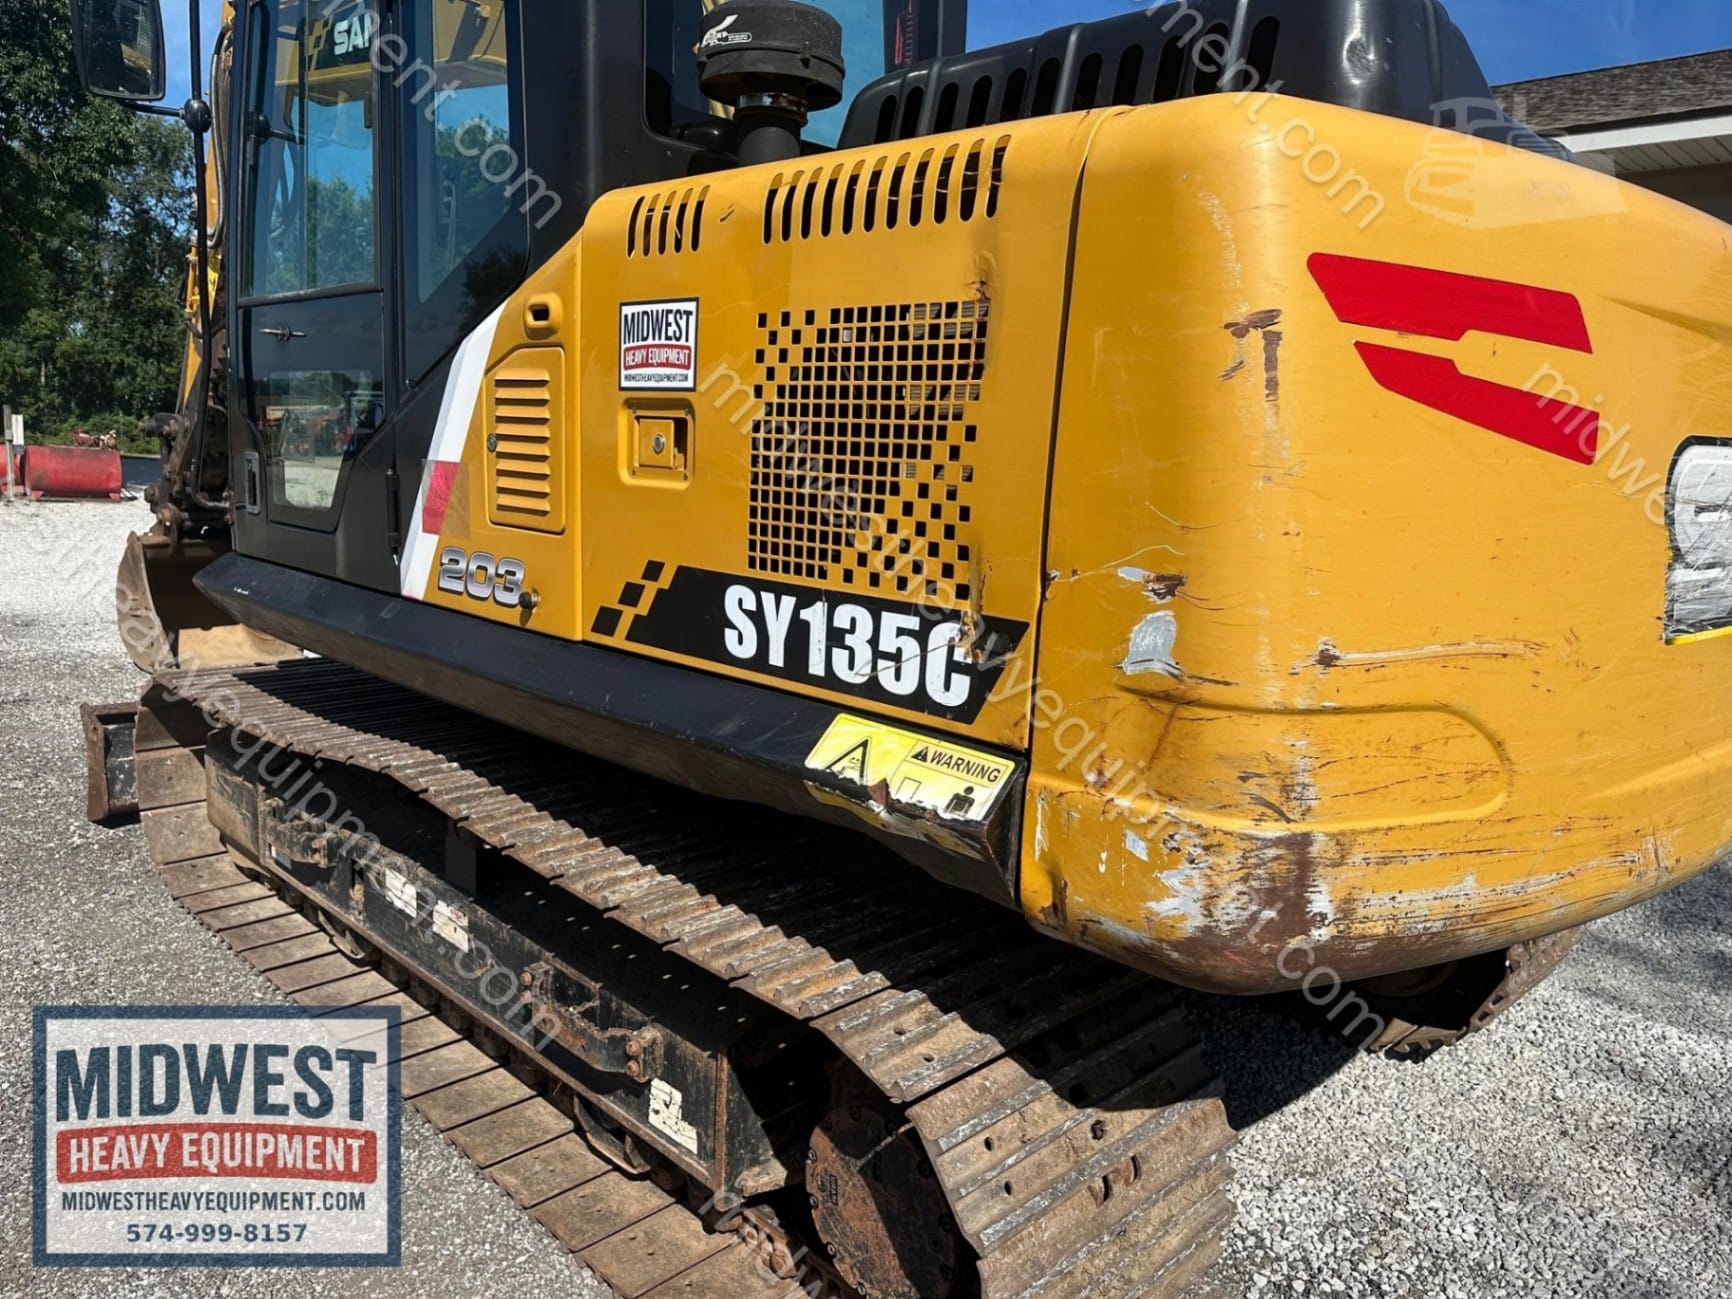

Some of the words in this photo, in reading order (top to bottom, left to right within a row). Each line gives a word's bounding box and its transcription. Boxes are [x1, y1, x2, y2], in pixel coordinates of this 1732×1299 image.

[623, 309, 693, 345] MIDWEST
[625, 349, 648, 367] HEAVY
[648, 347, 690, 367] EQUIPMENT
[438, 546, 526, 608] 203
[724, 584, 972, 707] SY135C
[930, 750, 1001, 783] WARNING
